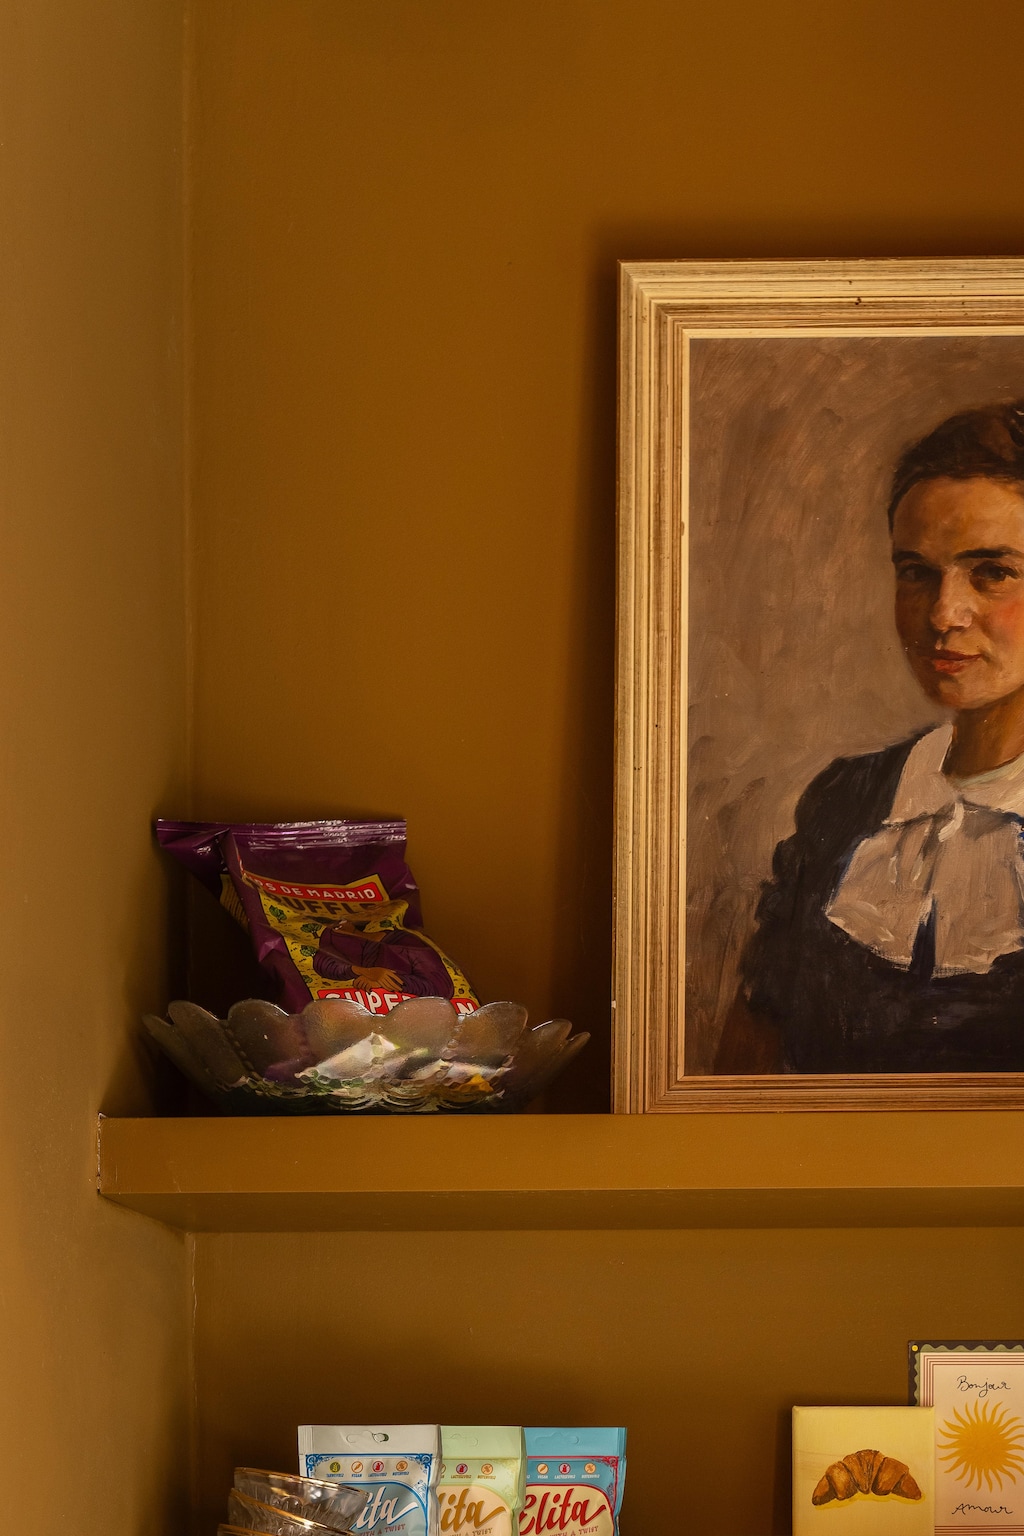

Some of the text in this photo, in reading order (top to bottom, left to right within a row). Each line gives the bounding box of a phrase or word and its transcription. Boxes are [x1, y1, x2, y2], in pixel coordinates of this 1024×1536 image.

[280, 885, 376, 900] DE MADRID
[957, 1375, 1011, 1398] Bonjour
[349, 1486, 419, 1531] ita
[519, 1488, 607, 1536] Elita
[952, 1503, 1013, 1515] Amour
[579, 1525, 599, 1535] TWIST
